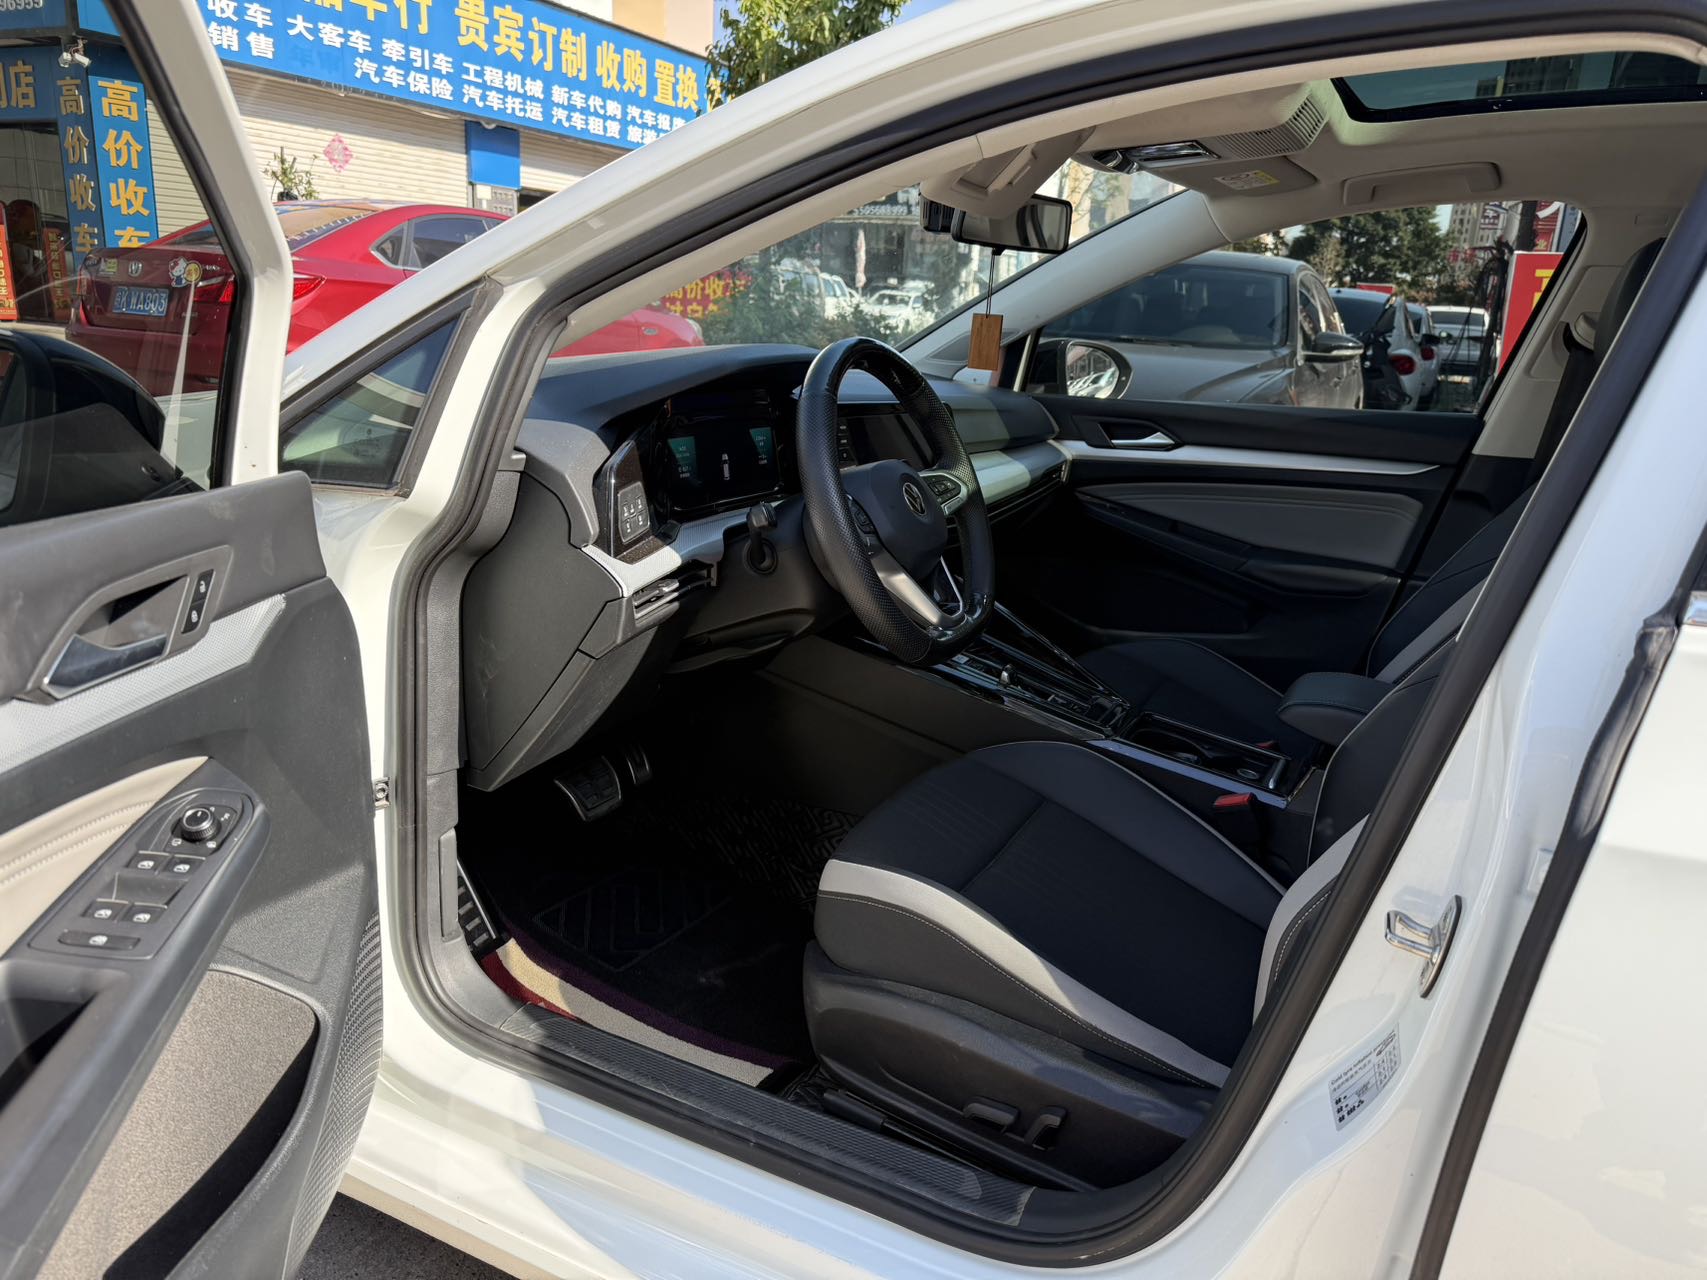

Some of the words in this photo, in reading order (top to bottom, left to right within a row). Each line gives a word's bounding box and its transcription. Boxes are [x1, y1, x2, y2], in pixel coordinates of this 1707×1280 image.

[207, 21, 275, 59] 销售
[353, 57, 454, 101] 汽车保险
[461, 84, 544, 122] 汽车托运
[551, 106, 621, 139] 汽车租赁
[286, 14, 373, 54] 大客车
[382, 38, 454, 75] 牵引车
[461, 62, 545, 100] 工程机械
[551, 84, 623, 120] 新车代购
[454, 0, 588, 81] 贵宾订制
[596, 40, 648, 98] 收购
[653, 58, 699, 112] 置换
[57, 76, 98, 254] 高价收车
